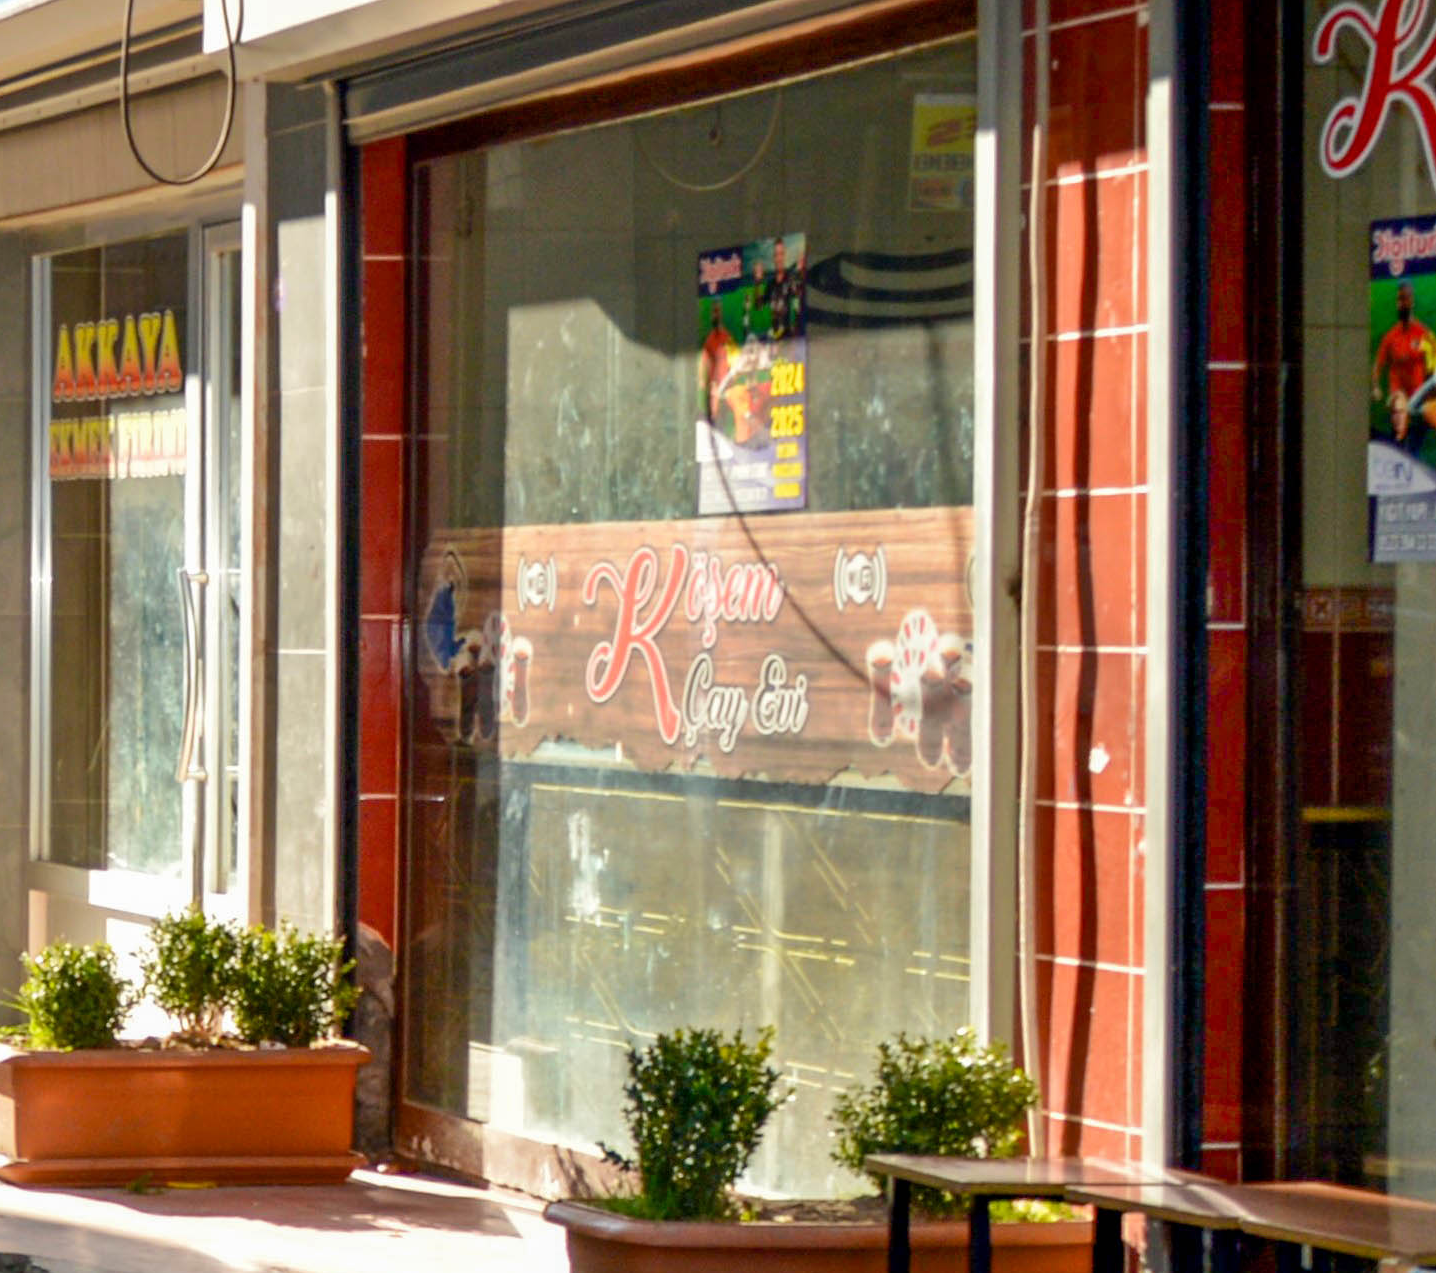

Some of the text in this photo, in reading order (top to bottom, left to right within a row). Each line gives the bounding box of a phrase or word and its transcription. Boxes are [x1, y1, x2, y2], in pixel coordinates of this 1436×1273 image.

[53, 309, 182, 402] AKKAYA
[770, 362, 807, 396] 2024
[770, 404, 805, 439] 2025
[682, 652, 809, 754] Çay Evi
